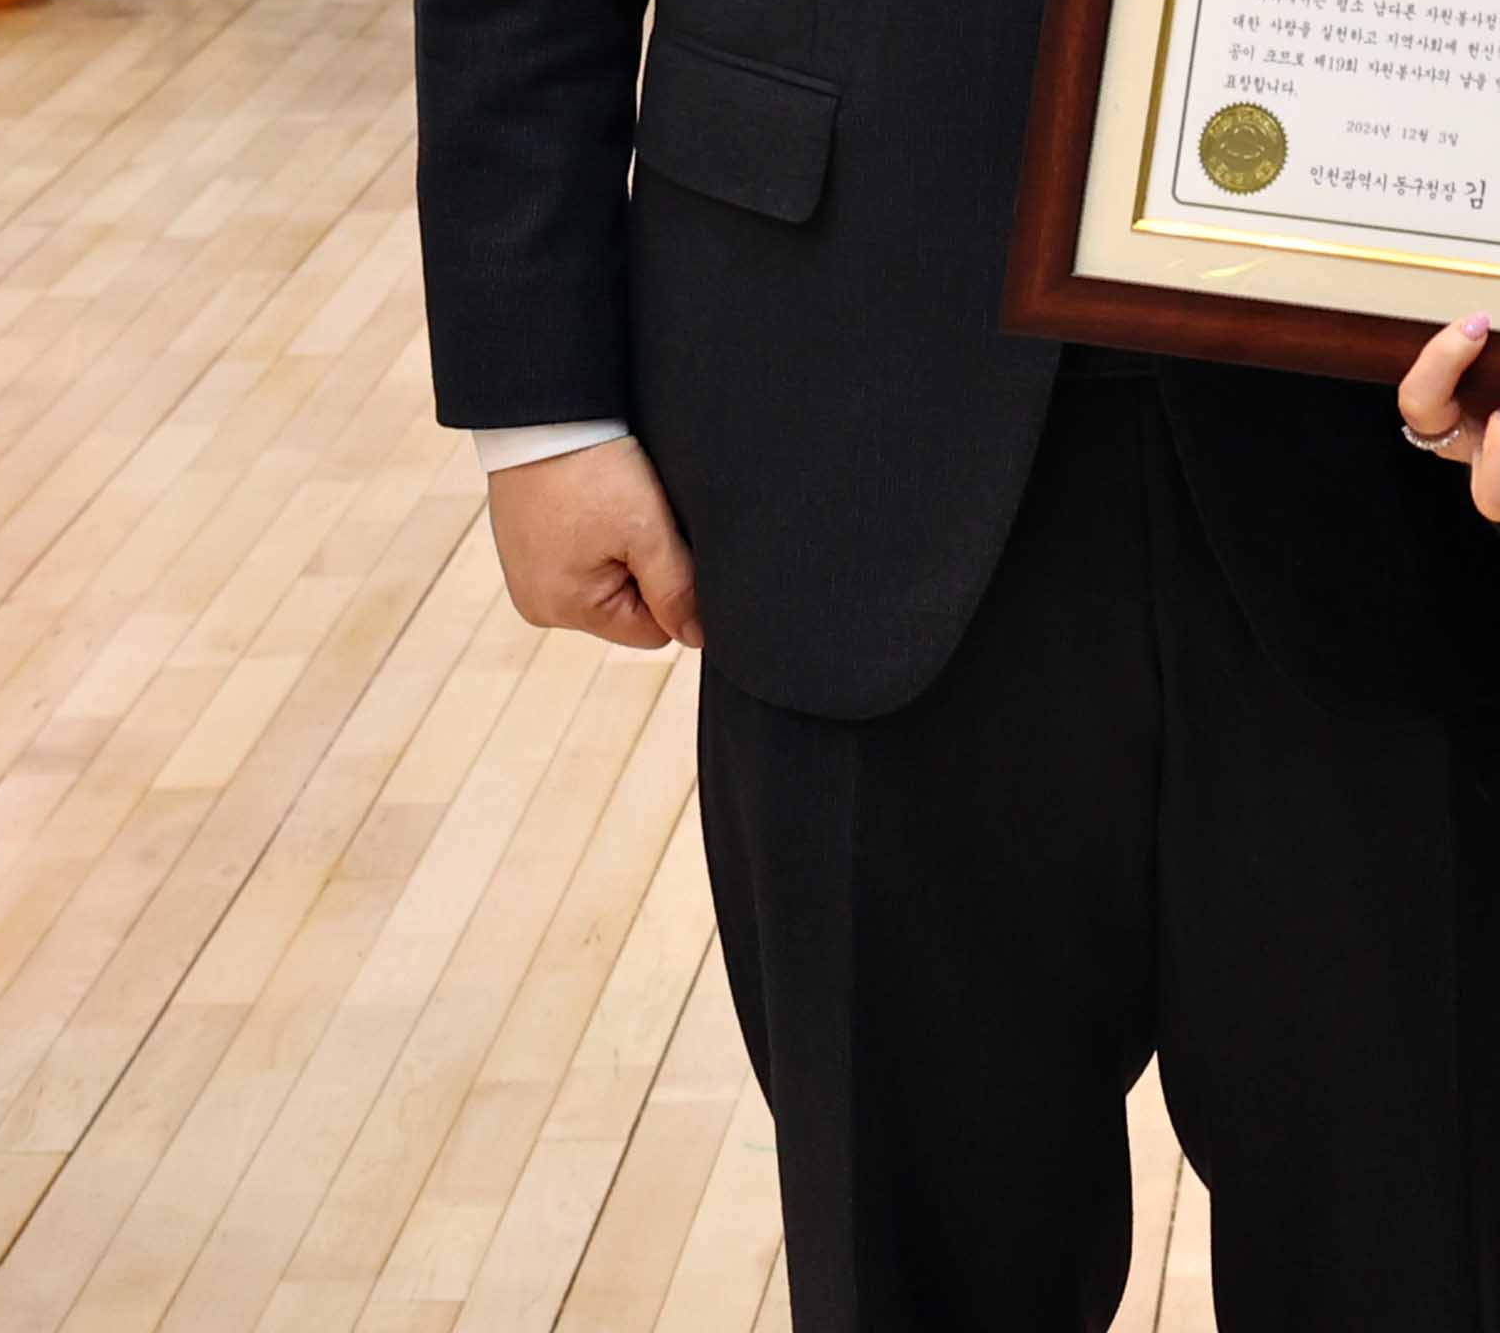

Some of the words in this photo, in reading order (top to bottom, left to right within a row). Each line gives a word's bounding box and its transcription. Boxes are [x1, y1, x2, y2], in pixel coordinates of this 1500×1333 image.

[1373, 0, 1416, 20] 남다른
[1233, 14, 1261, 33] 대한
[1269, 18, 1311, 38] 사랑을
[1322, 24, 1378, 45] 실천하고
[1388, 32, 1458, 54] 지역사회에
[1228, 43, 1255, 61] 공이
[1368, 60, 1451, 84] 자원봉사자의
[1459, 72, 1487, 92] 날을
[1347, 121, 1391, 139] 2024년
